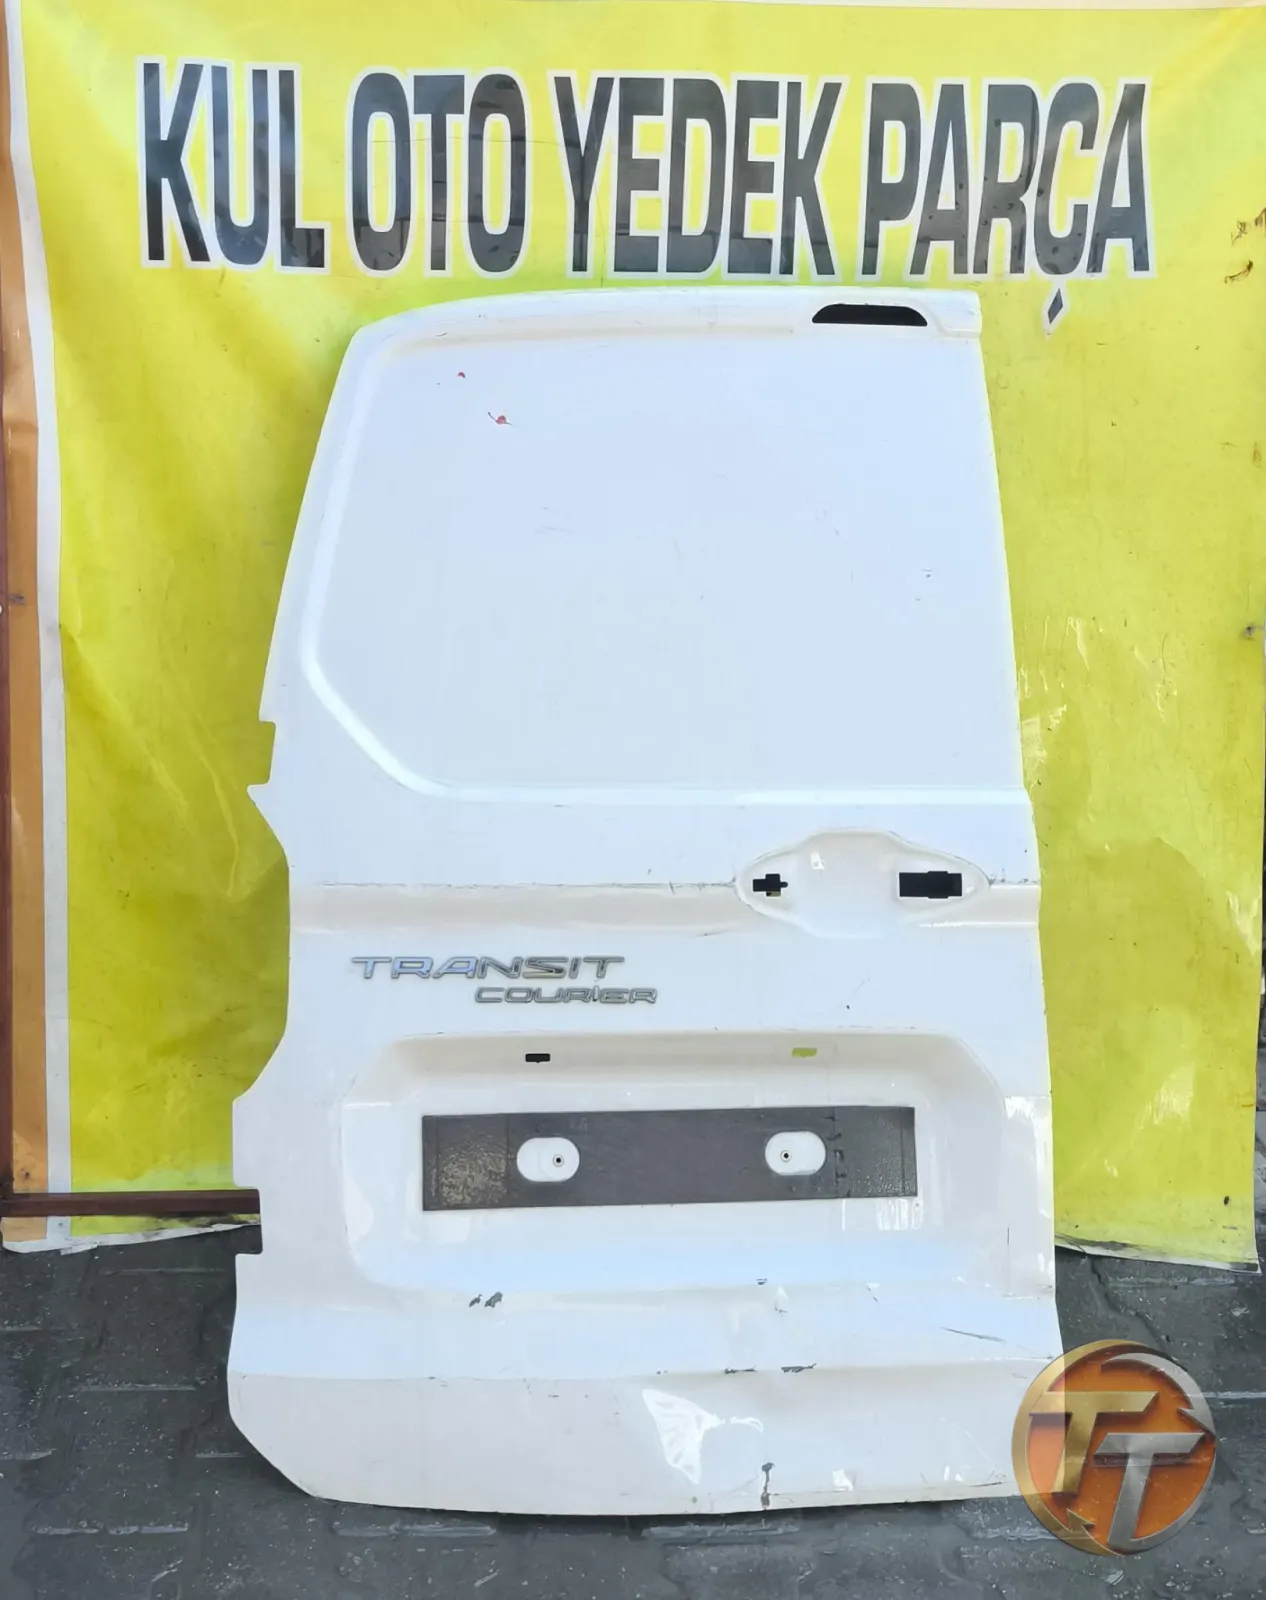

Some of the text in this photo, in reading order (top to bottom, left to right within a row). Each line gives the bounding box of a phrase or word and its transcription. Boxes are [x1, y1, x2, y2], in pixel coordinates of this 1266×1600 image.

[138, 58, 1154, 336] KUL OTO YEDEK PARÇA
[351, 956, 625, 979] TRANSIT
